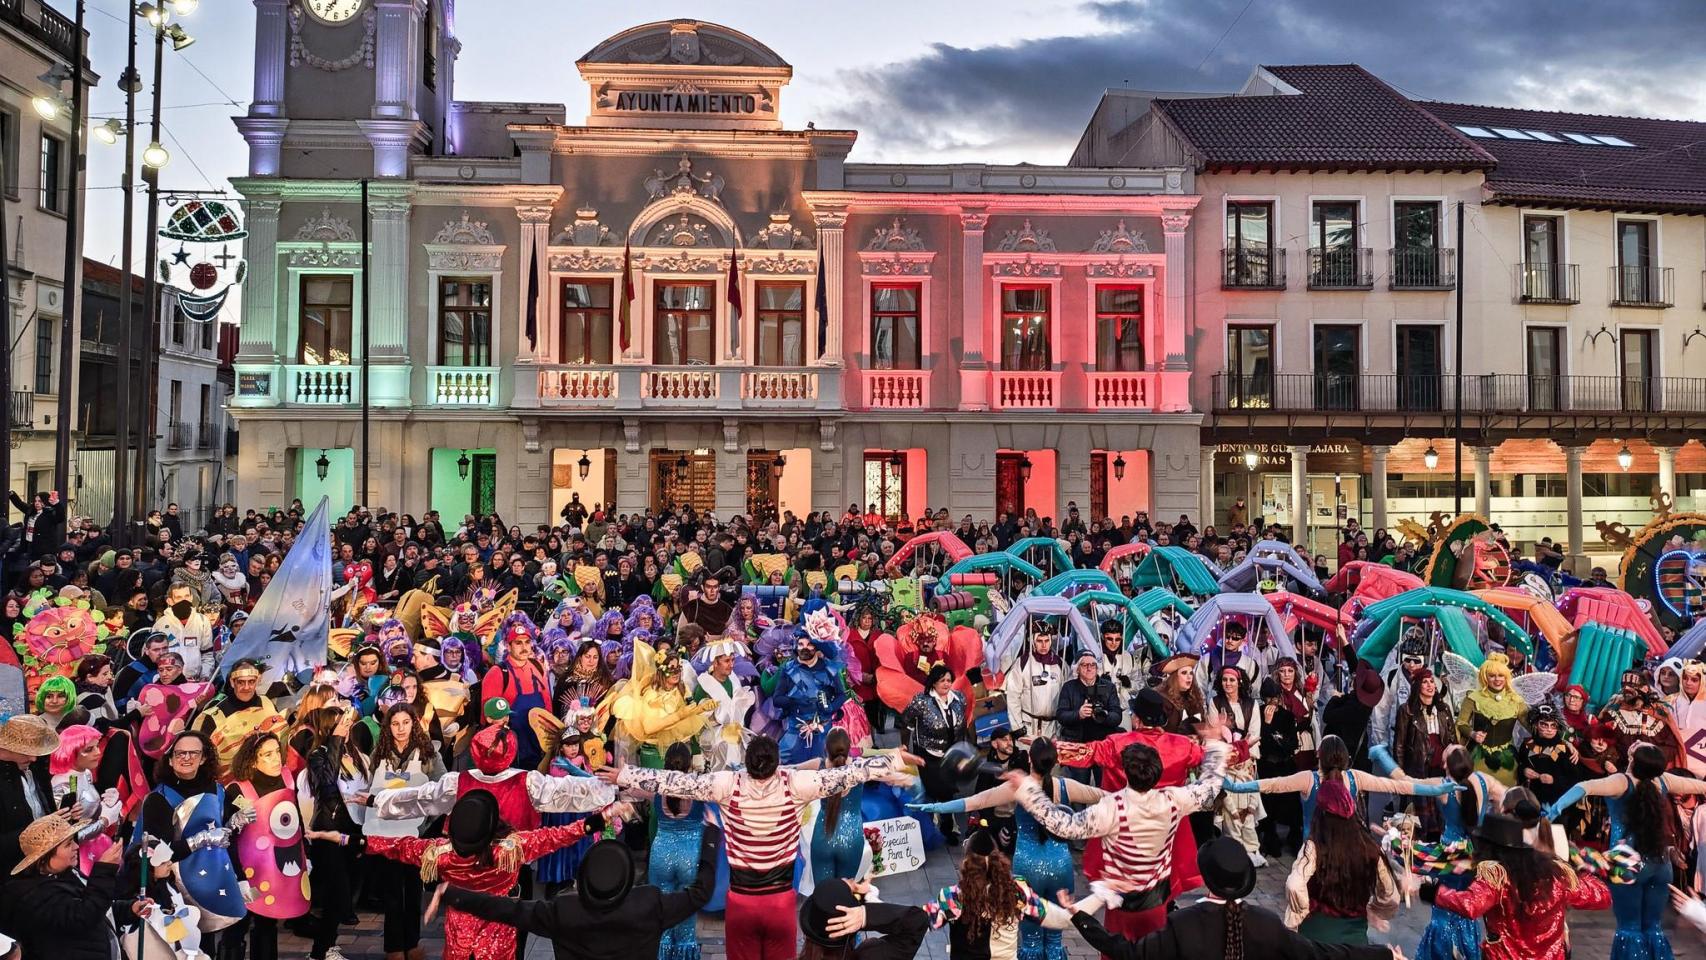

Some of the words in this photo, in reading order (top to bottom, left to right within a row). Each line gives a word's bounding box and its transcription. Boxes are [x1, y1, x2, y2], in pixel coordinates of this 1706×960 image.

[616, 92, 755, 113] AYUNTAMIENTO
[1254, 443, 1268, 452] DE
[1229, 455, 1286, 464] OFINAS
[498, 701, 505, 709] L
[882, 822, 895, 834] Un
[895, 820, 916, 831] Ramo
[888, 849, 903, 860] Para
[906, 846, 912, 857] ti
